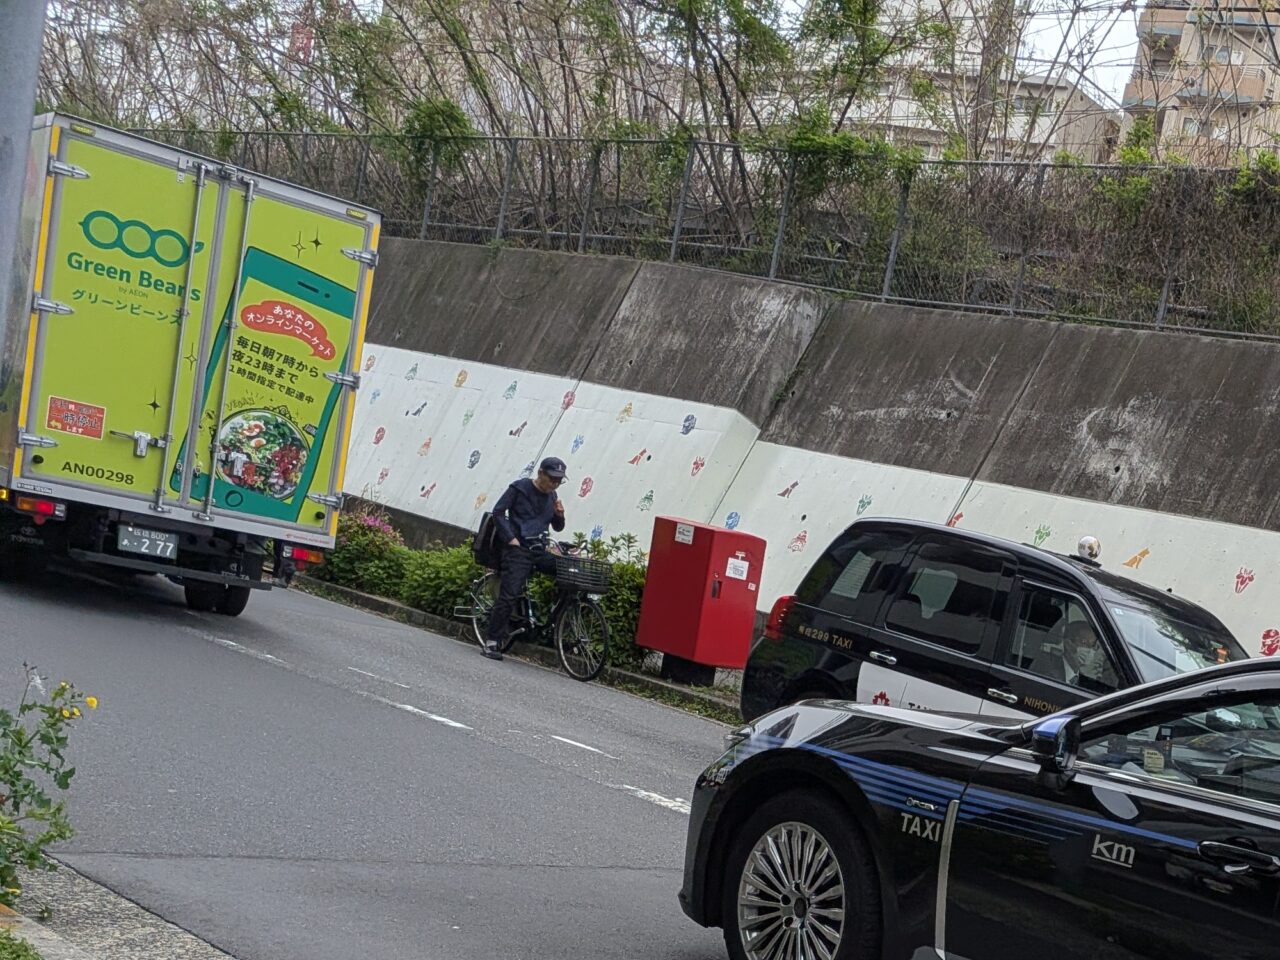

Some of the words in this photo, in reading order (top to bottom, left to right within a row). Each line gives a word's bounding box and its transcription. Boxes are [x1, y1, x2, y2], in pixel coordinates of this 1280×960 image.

[67, 252, 131, 284] Green
[138, 270, 201, 301] Beans
[129, 289, 149, 299] AEON
[273, 305, 314, 330] あなたの
[246, 312, 331, 356] オンラインマーケット
[232, 349, 298, 384] 夜23時まで
[236, 335, 319, 378] 毎日朝7時から
[61, 461, 135, 486] AN00298
[831, 634, 853, 649] TAXI
[900, 812, 941, 842] TAXI
